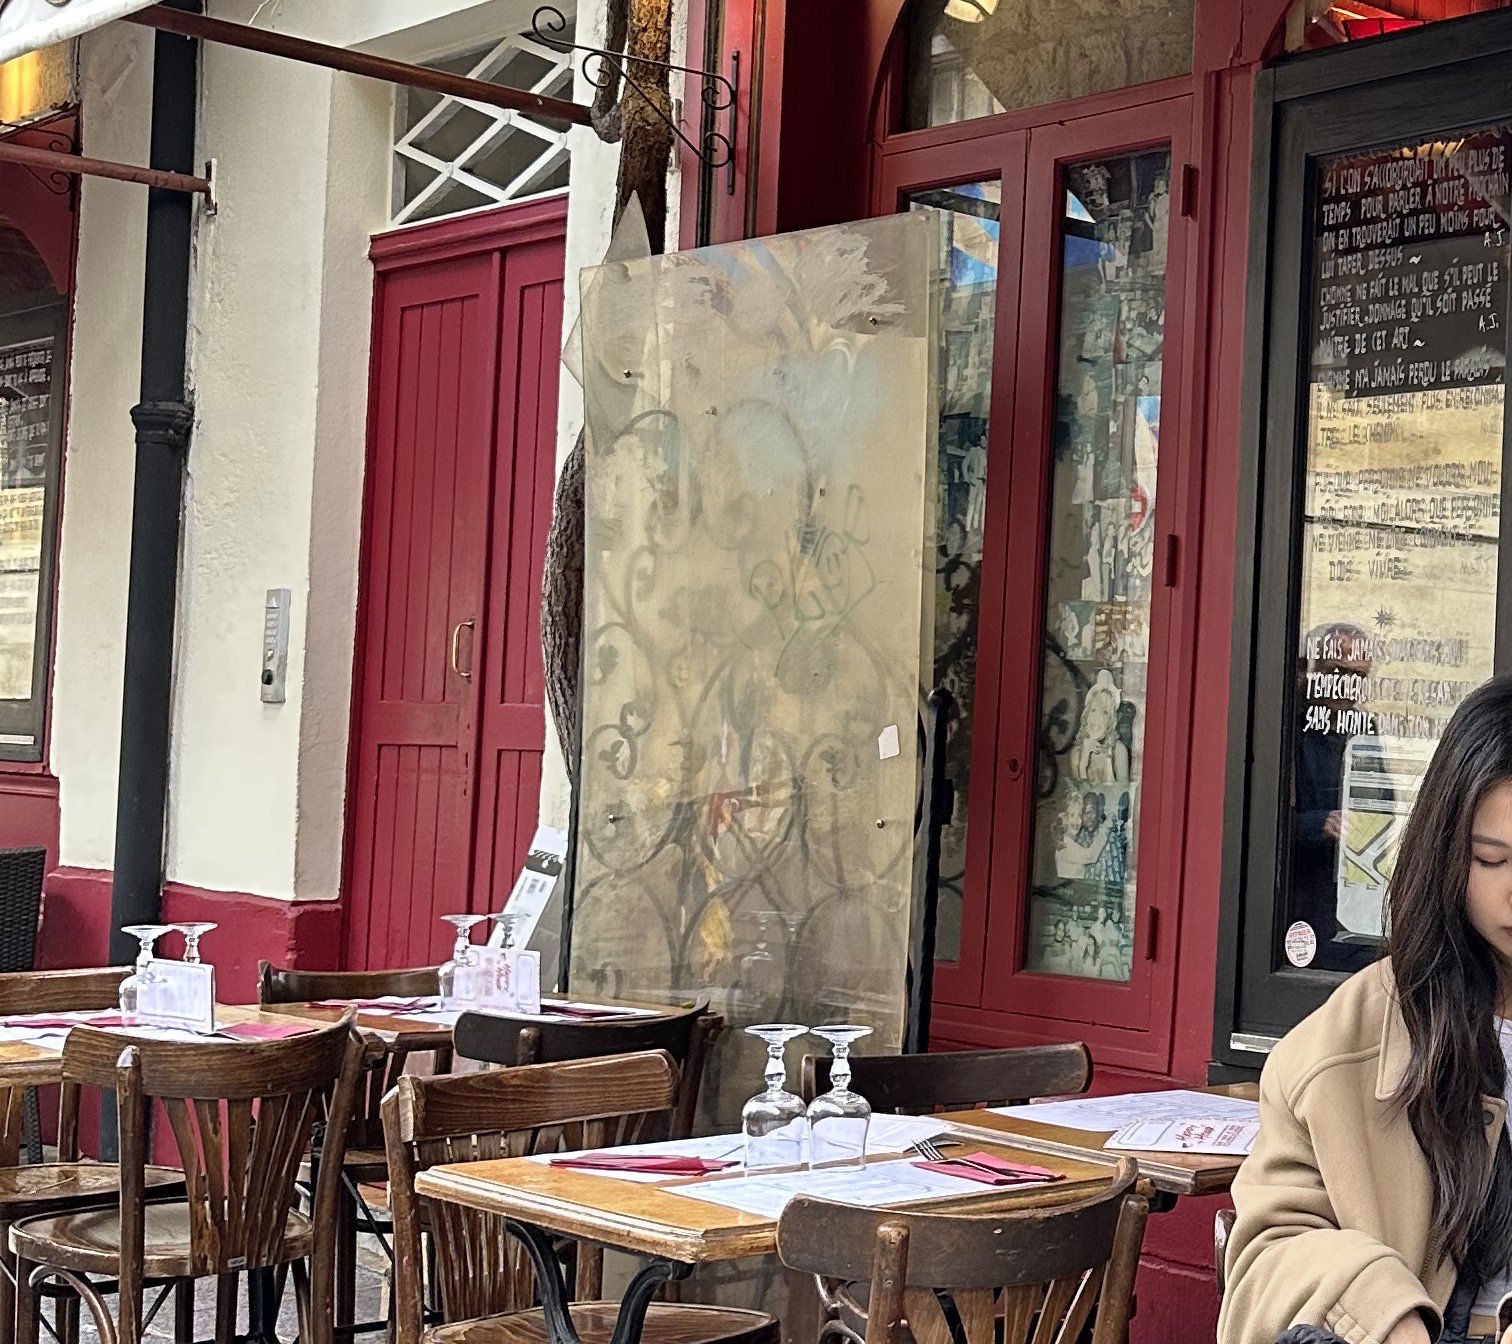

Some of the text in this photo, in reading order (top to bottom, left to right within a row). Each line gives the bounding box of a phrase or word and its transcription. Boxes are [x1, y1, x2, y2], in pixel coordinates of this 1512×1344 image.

[1468, 148, 1489, 173] PLUS
[1492, 146, 1505, 172] DE
[1323, 202, 1350, 226] TEMPS
[1361, 196, 1386, 220] POUR
[1388, 187, 1423, 214] PARLER
[1435, 178, 1465, 206] NOTRE
[1322, 231, 1336, 253] ON
[1404, 215, 1417, 237] UN
[1419, 213, 1436, 236] PEU
[1440, 206, 1469, 233] MOINS
[1473, 206, 1500, 229] POUR
[1338, 253, 1366, 276] TAPER
[1368, 246, 1402, 270] DESSUS
[1369, 272, 1387, 299] FAIT
[1389, 276, 1399, 297] LE
[1402, 273, 1419, 294] MAL
[1421, 270, 1440, 296] QUE
[1462, 262, 1484, 286] PEUT
[1487, 261, 1499, 282] LE
[1436, 287, 1457, 316] SOIT
[1355, 326, 1410, 354] DE CET ART
[1371, 358, 1405, 388] JAMAIS
[1408, 360, 1437, 387] PERDU
[1441, 360, 1451, 382] LE
[1306, 636, 1320, 660] NE
[1323, 630, 1343, 660] FAIS
[1303, 706, 1331, 735] SANS
[1337, 710, 1376, 736] HONTE
